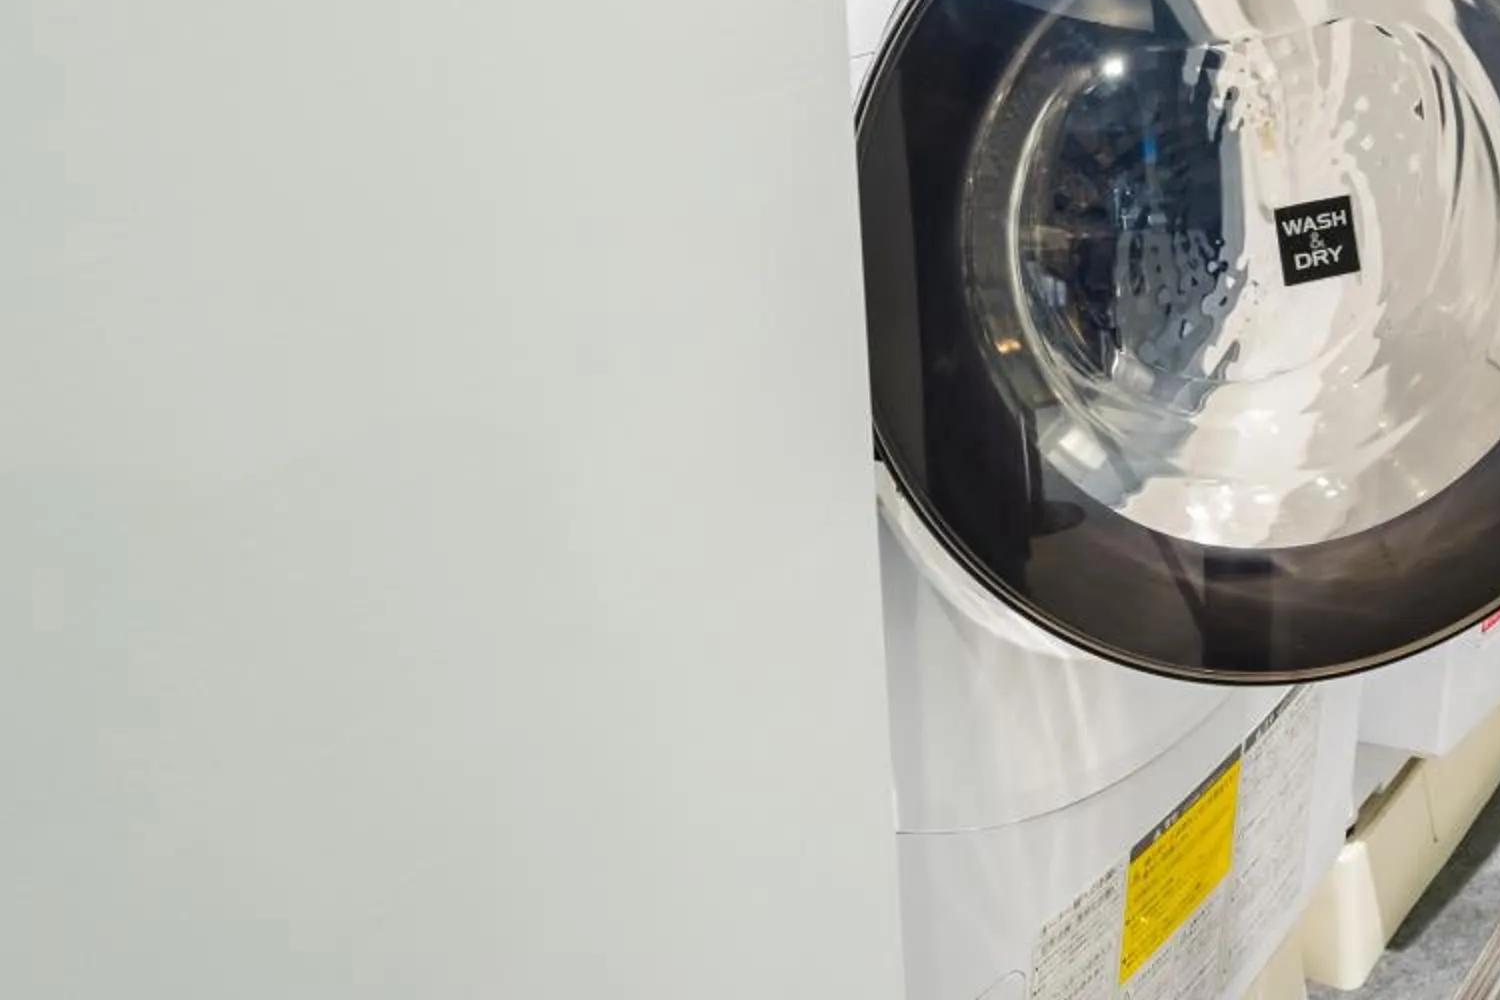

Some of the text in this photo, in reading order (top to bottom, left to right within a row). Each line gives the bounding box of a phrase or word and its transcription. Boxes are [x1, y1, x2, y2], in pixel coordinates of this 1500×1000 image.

[1282, 209, 1348, 237] WASH
[1310, 231, 1326, 249] &
[1293, 245, 1343, 271] DRY
